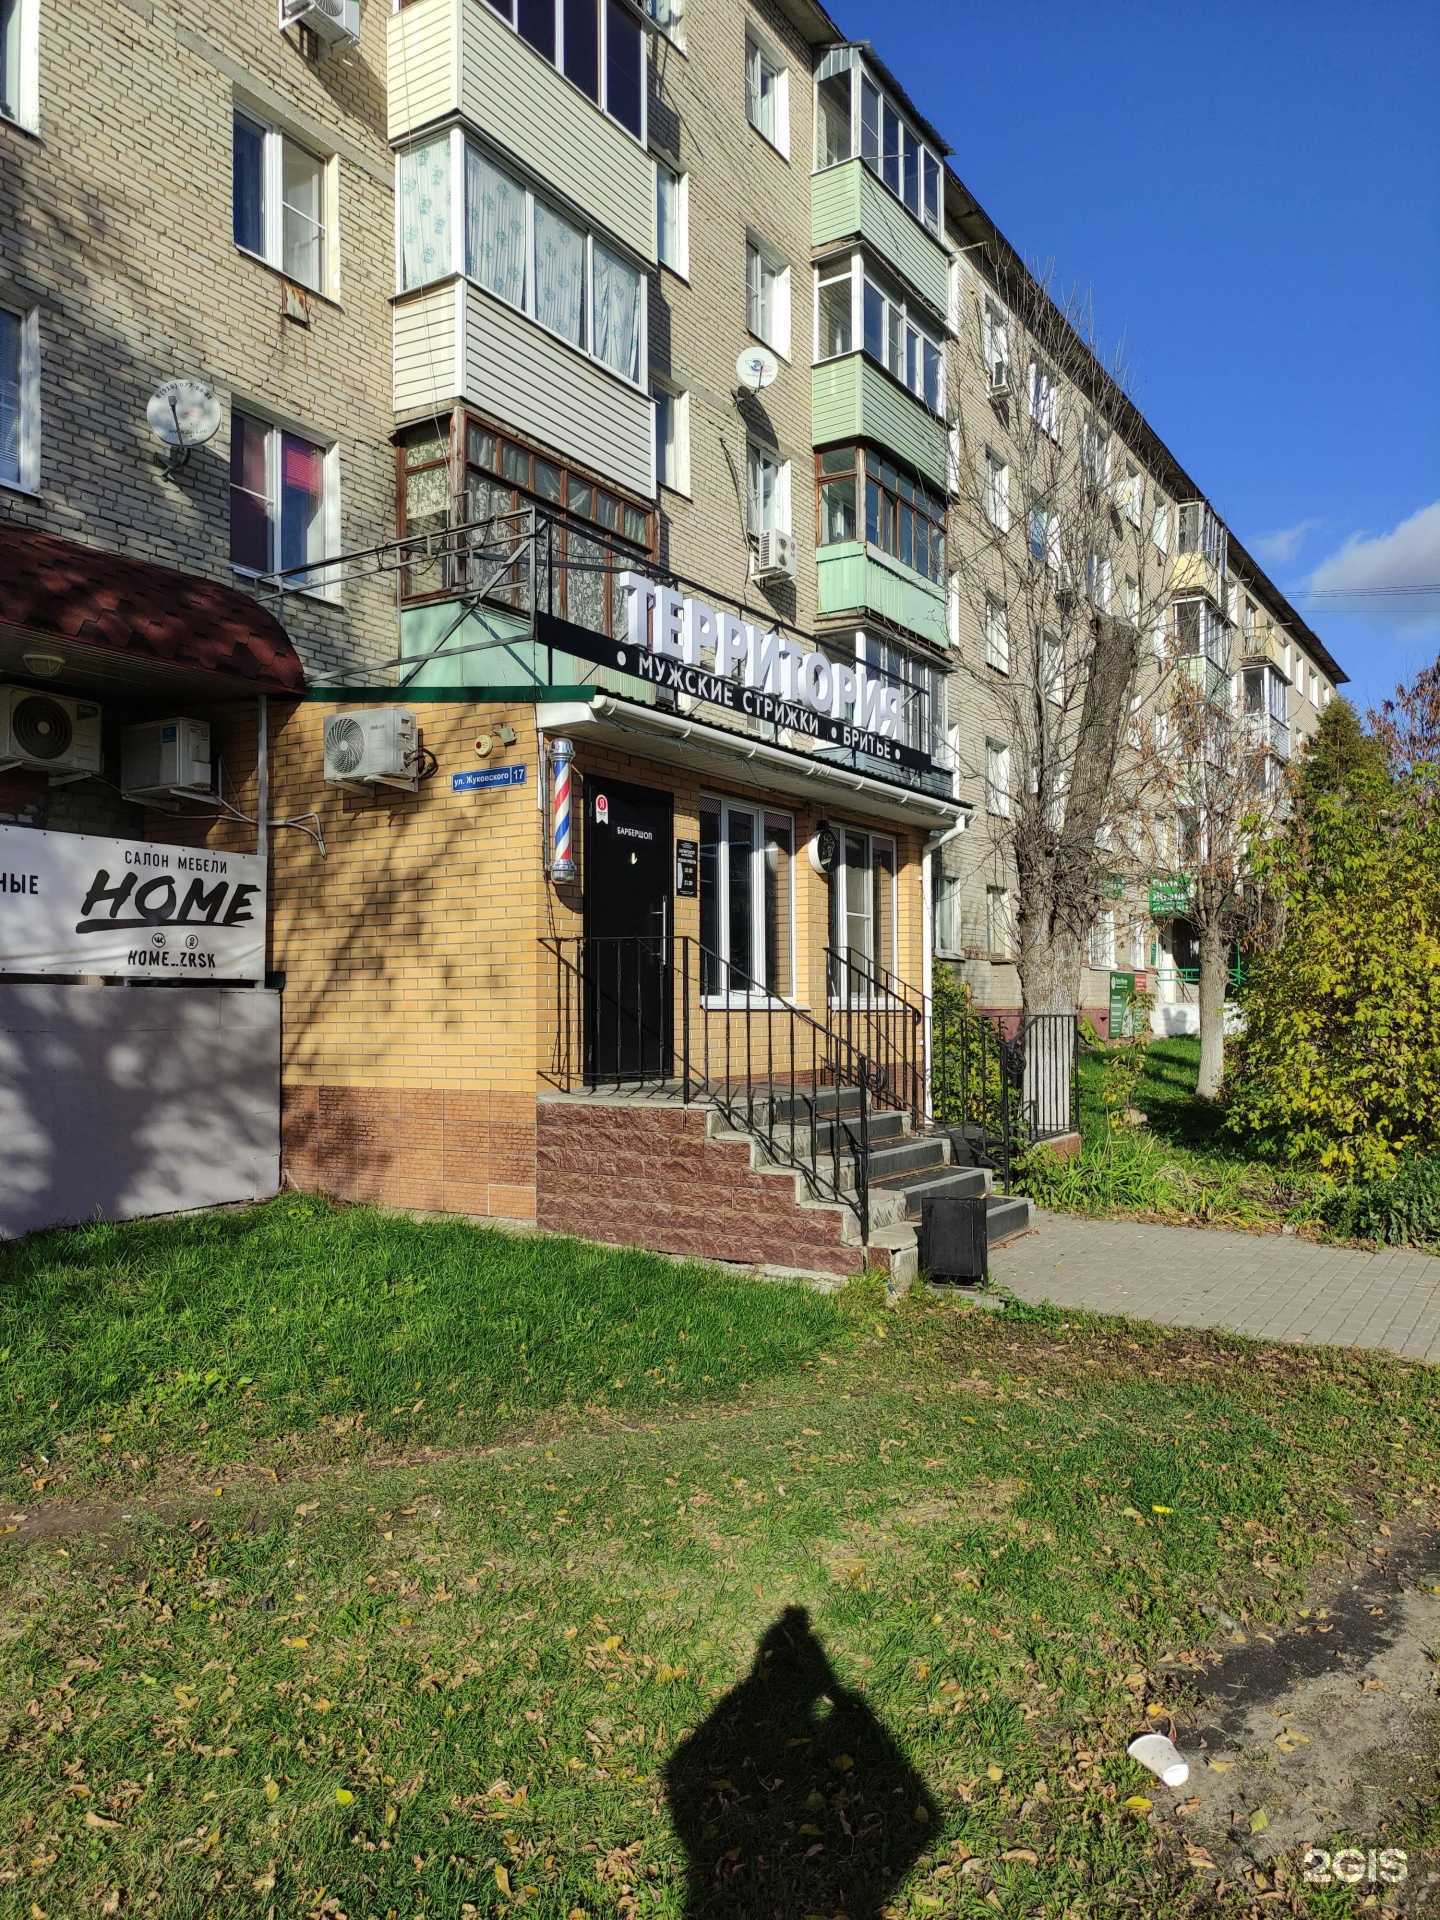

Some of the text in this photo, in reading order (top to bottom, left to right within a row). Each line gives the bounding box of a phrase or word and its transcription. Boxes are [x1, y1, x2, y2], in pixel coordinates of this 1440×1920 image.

[620, 571, 904, 741] ТЕРРИТОРИЯ
[638, 652, 892, 760] МУЖСКИЕ СТРИЖКИ БРИТЬЕ
[454, 769, 525, 787] ул. Жуковского 17
[616, 826, 653, 841] БАРБЕРШОП
[125, 850, 228, 874] САЛОН МЕБЕЛИ
[80, 869, 261, 924] HOME
